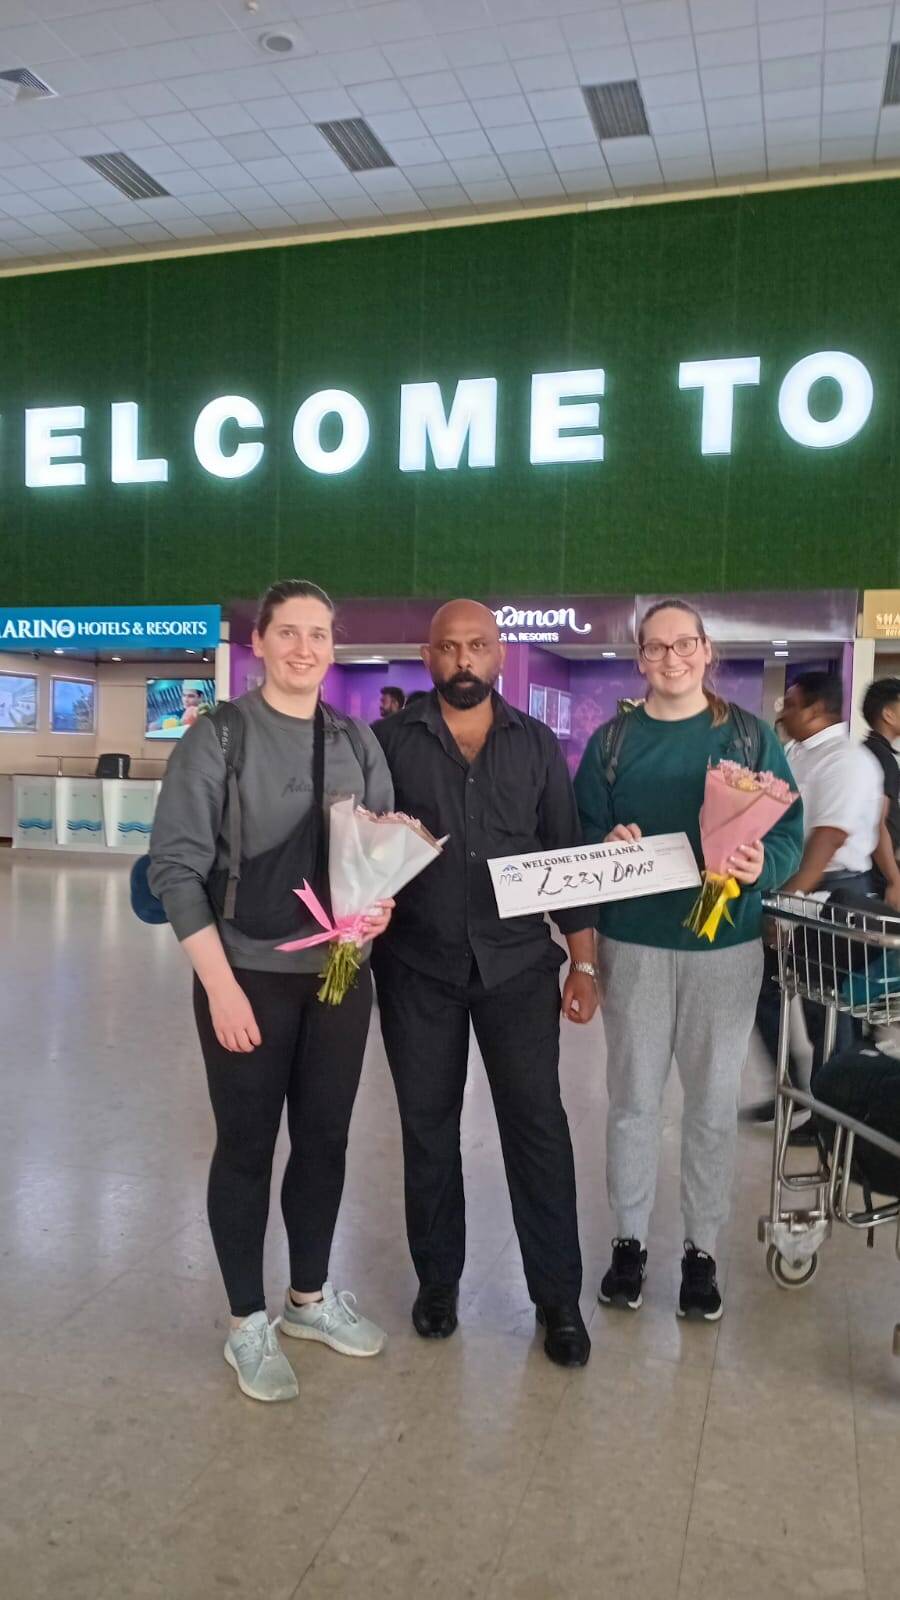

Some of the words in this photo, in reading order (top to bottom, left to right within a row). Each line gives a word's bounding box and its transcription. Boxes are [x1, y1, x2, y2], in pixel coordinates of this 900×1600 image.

[0, 369, 605, 488] ELCOME
[678, 350, 874, 456] TO
[0, 619, 76, 639] ARINO
[78, 621, 130, 636] HOTELS
[132, 621, 144, 636] &
[146, 621, 207, 636] RESORTS
[518, 632, 560, 643] RESORTS
[521, 855, 572, 870] WELCOME
[574, 852, 588, 862] TO
[589, 850, 607, 861] SRI
[608, 844, 644, 858] LANKA
